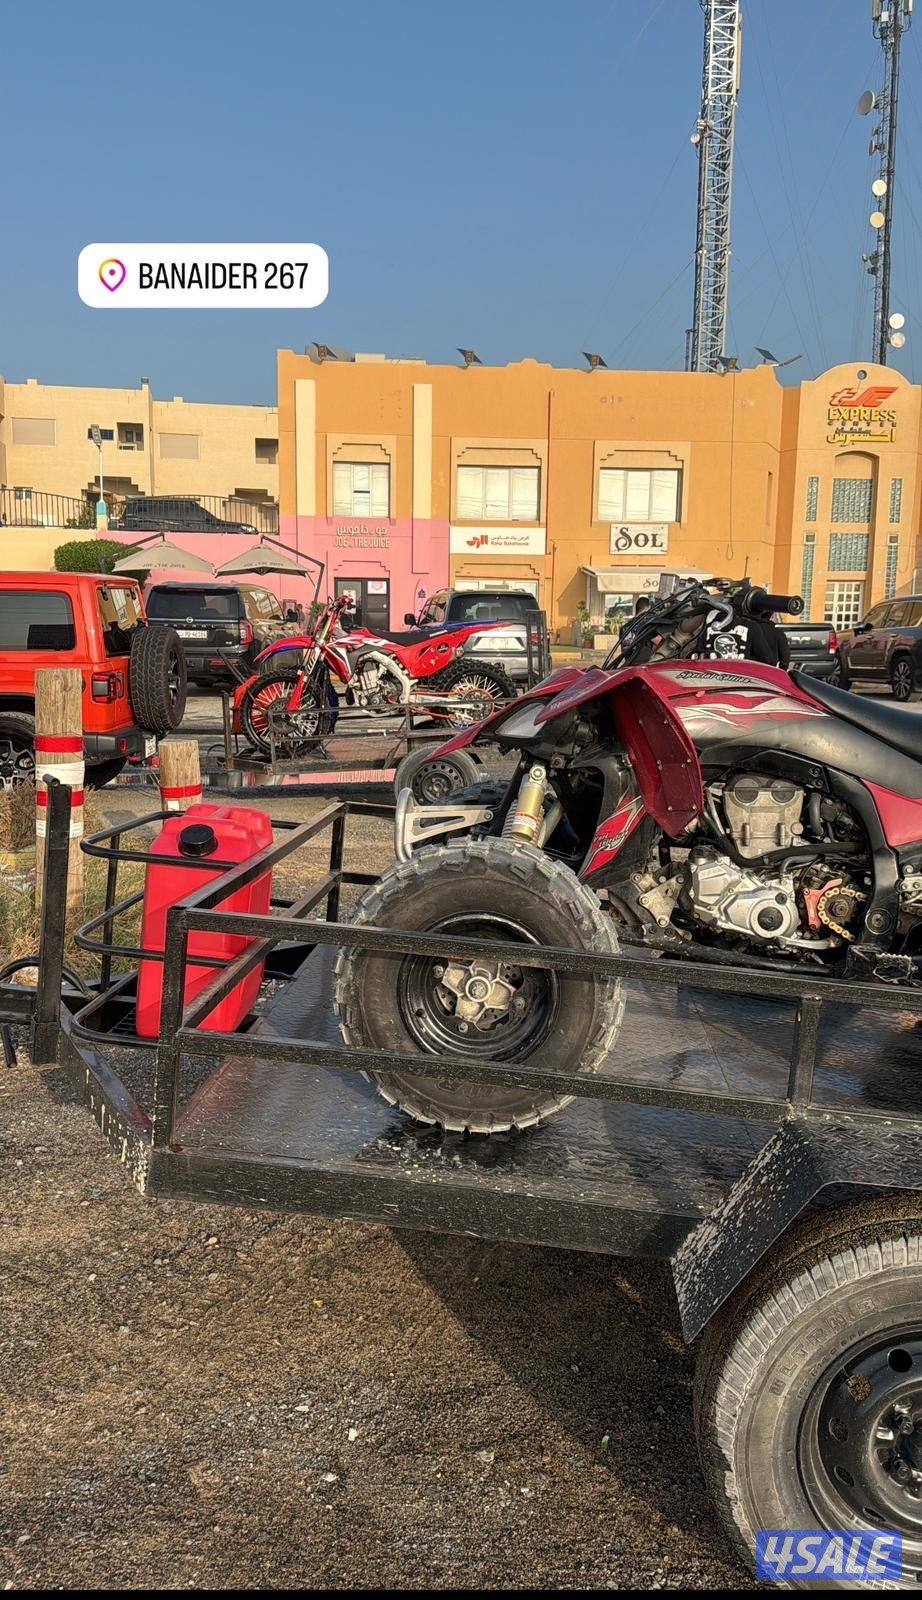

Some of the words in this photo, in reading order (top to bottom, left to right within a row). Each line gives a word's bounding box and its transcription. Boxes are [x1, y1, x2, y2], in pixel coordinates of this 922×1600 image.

[827, 408, 897, 422] EXPRESS
[334, 536, 348, 548] JOE
[353, 536, 369, 549] THE
[369, 537, 391, 549] JUICE
[614, 526, 664, 552] SOL
